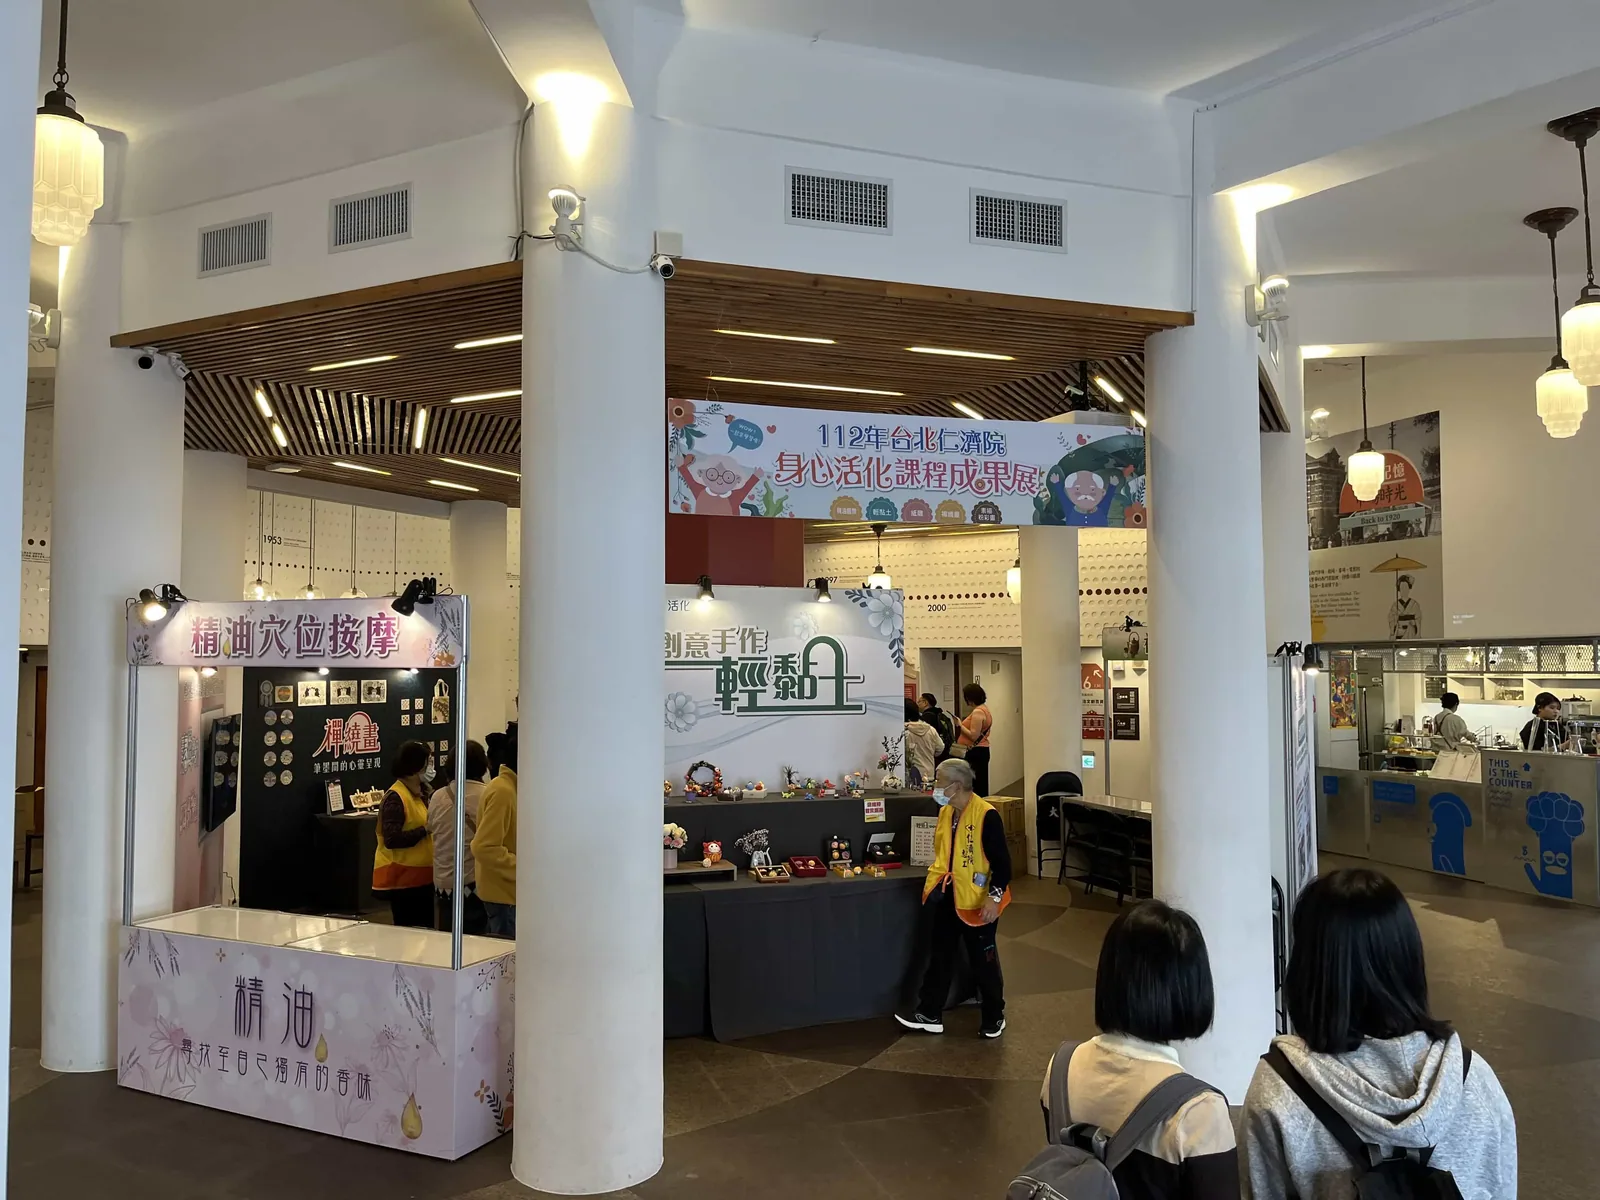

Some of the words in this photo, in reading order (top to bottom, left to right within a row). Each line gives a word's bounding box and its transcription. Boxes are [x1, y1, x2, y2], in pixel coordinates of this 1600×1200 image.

[818, 424, 1006, 455] 112年台北仁濟院
[774, 451, 1042, 497] 身心活化課程成果展
[1360, 516, 1377, 525] Back
[1385, 513, 1401, 522] 1920
[263, 534, 282, 545] 1953
[667, 600, 690, 612] 活化
[927, 603, 947, 612] 2000
[191, 612, 400, 657] 精油穴位按摩
[664, 627, 768, 659] 創意手作
[714, 635, 864, 712] 輕黏土
[314, 711, 381, 757] 禪繞畫
[1488, 758, 1510, 768] THIS
[1488, 768, 1498, 777] IS
[1500, 769, 1519, 779] THE
[1488, 778, 1533, 789] COUNTER
[234, 975, 313, 1049] 精油
[181, 1038, 372, 1101] 尋找至自己獨有的香味
